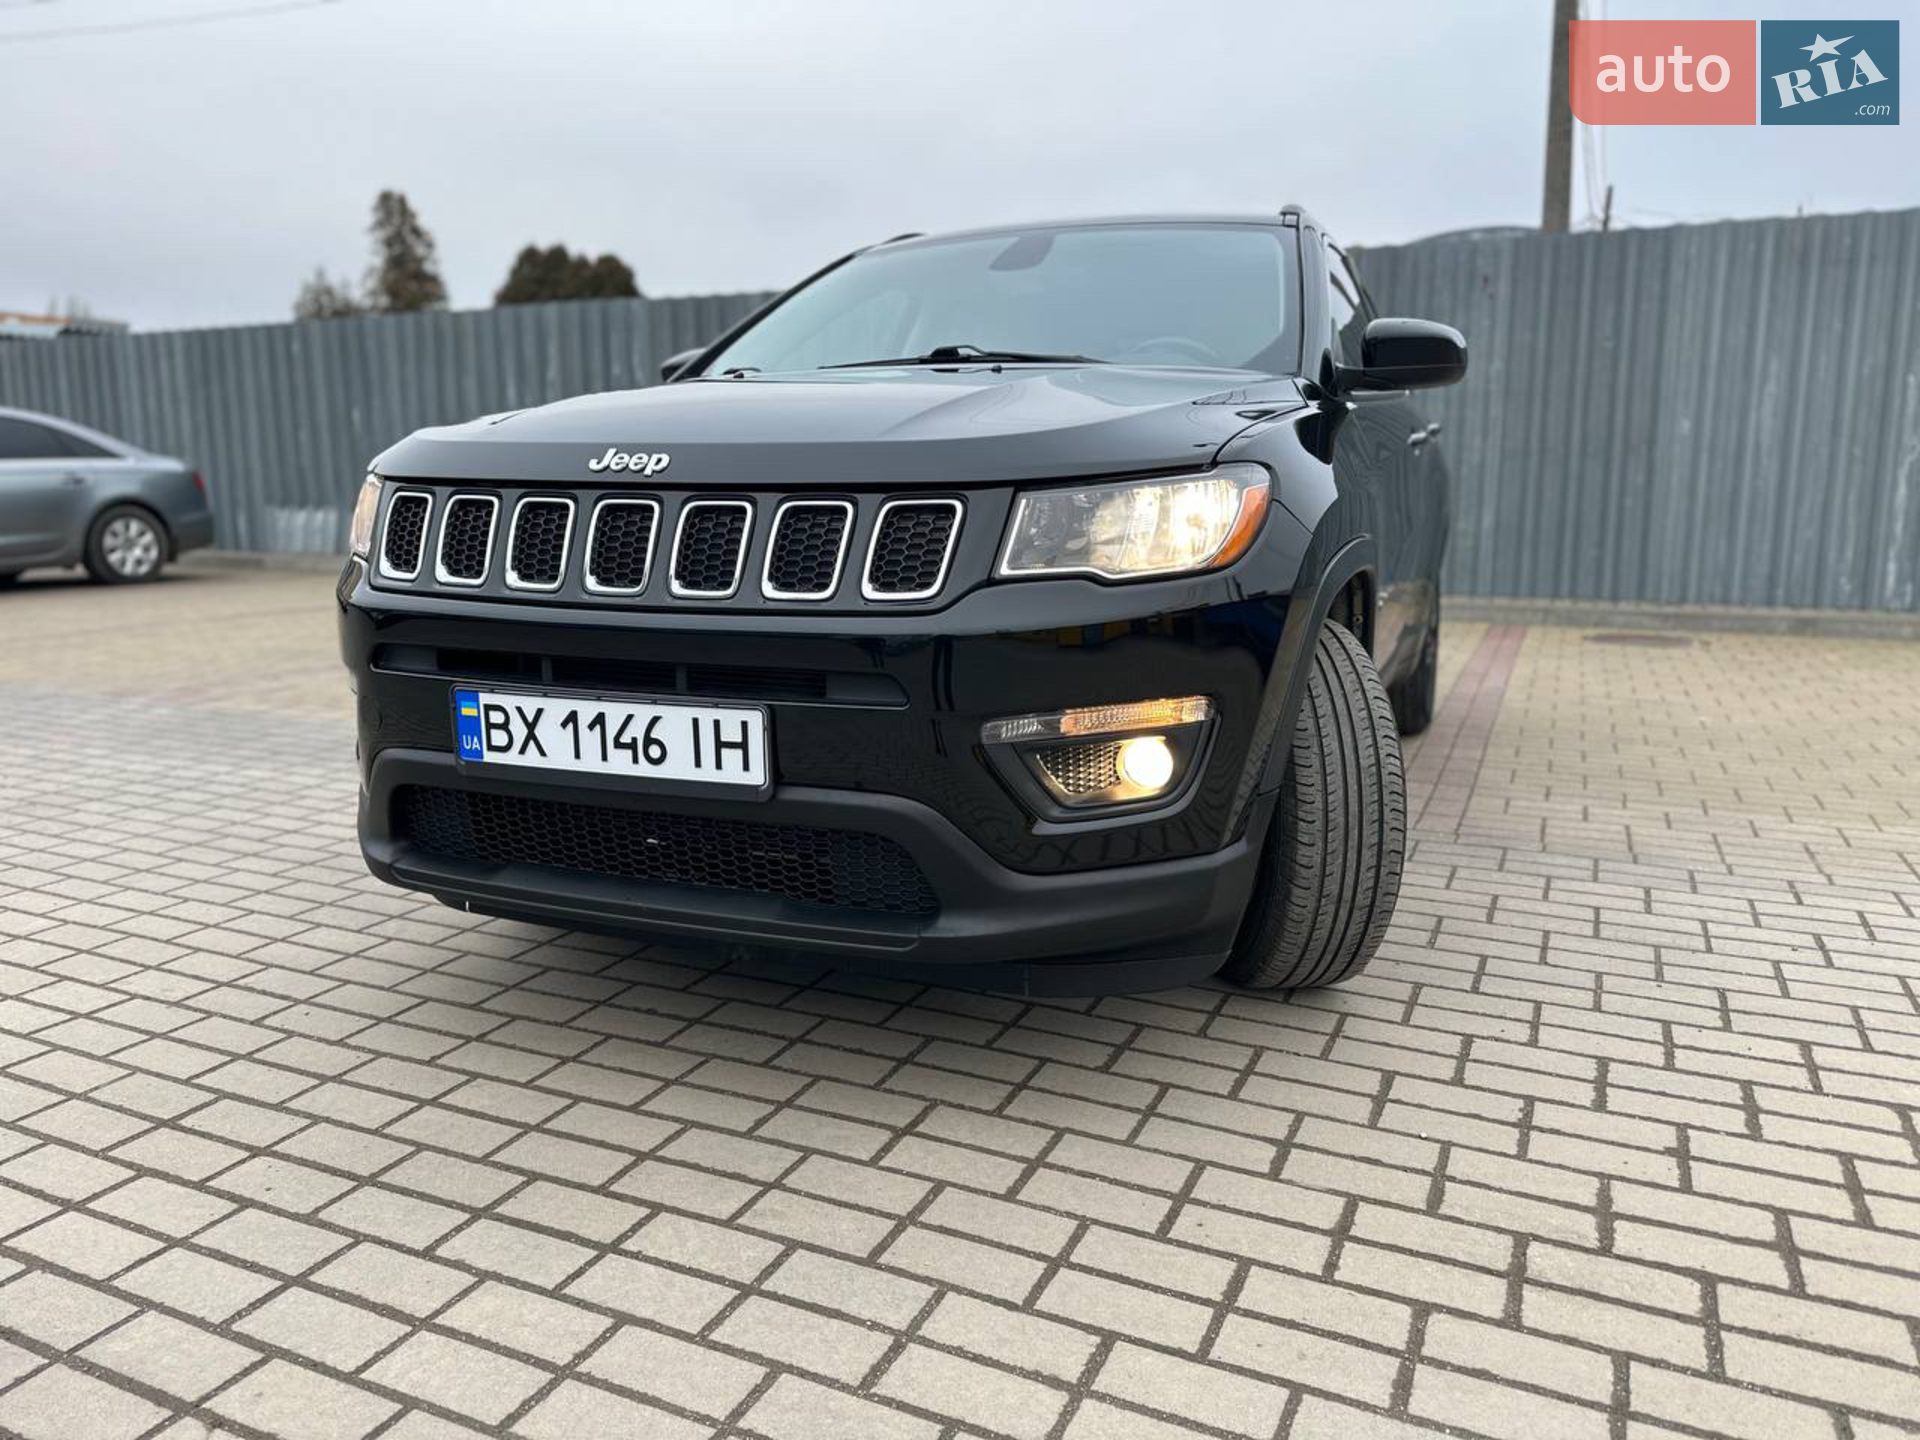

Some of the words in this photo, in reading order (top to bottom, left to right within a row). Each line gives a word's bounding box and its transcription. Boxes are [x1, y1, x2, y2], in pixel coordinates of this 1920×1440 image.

[588, 447, 670, 477] Jeep
[462, 734, 481, 751] UA
[482, 703, 548, 757] BX
[559, 709, 668, 767] 1146
[691, 716, 751, 773] IH
